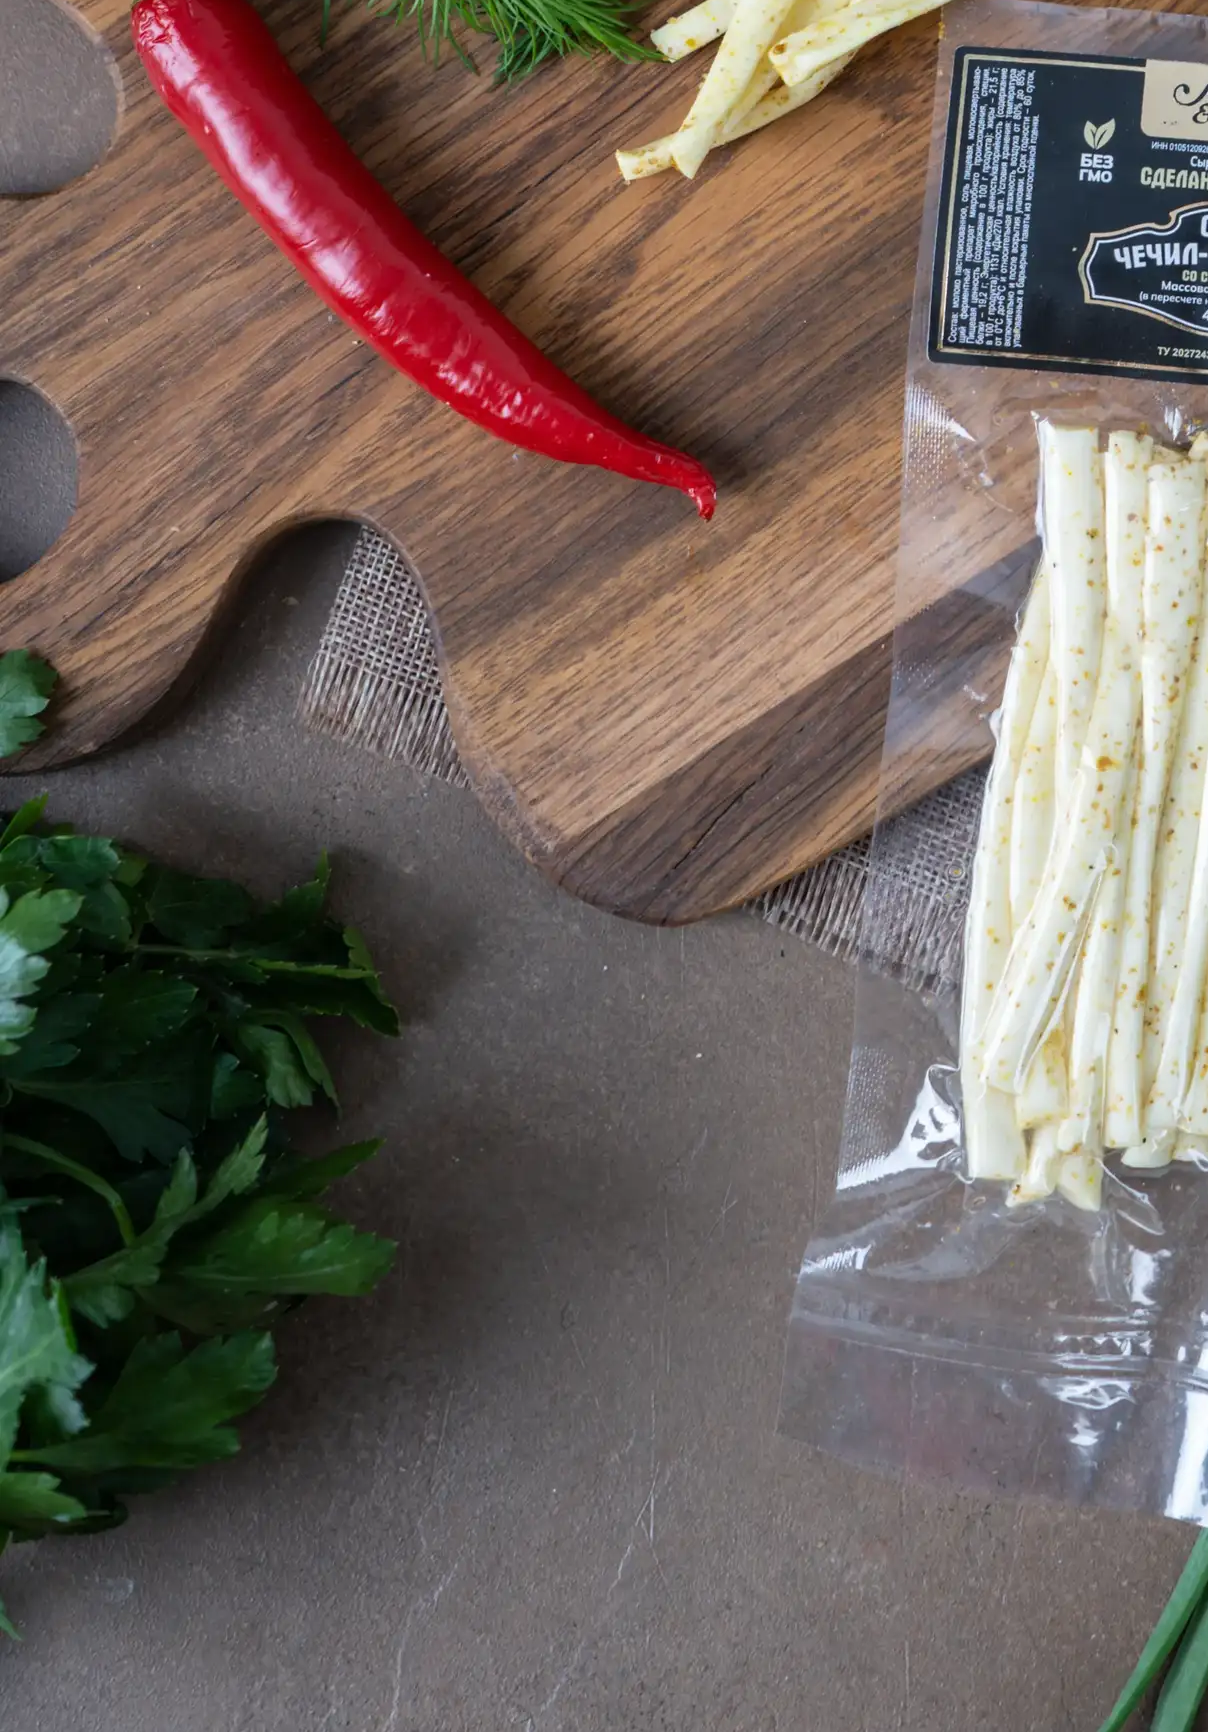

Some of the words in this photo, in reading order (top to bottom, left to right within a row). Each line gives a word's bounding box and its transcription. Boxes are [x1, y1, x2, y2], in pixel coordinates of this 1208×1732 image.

[989, 77, 999, 93] 21,5
[1016, 69, 1025, 85] 85%
[1026, 70, 1036, 92] суток,
[968, 66, 982, 139] молокосвертываю-
[995, 68, 1008, 117] (содержание
[1005, 68, 1017, 118] температура
[1016, 89, 1024, 100] до
[1023, 95, 1032, 105] 60
[987, 107, 996, 128] жиры
[1013, 102, 1022, 119] 80%
[974, 104, 987, 165] происхождения,
[1002, 120, 1012, 159] хранения:
[1013, 123, 1020, 132] от
[1020, 116, 1030, 151] годности
[964, 143, 974, 179] пищевая,
[982, 132, 994, 172] продукта):
[1010, 135, 1021, 165] воздуха
[1080, 153, 1114, 169] БЕЗ
[1151, 141, 1168, 151] ИНН
[987, 121, 1003, 212] ценность/калорийность
[997, 162, 1008, 194] Условия
[1017, 153, 1027, 173] Срок
[1024, 145, 1037, 200] многослойной
[1079, 168, 1113, 183] ГМО
[961, 183, 969, 201] соль
[968, 172, 981, 217] микробного
[978, 184, 987, 197] 100
[1006, 170, 1016, 210] влажность
[1015, 176, 1026, 213] упаковки.
[996, 198, 1004, 216] ккал.
[1024, 202, 1031, 211] из
[955, 206, 968, 275] пастеризованное,
[973, 212, 986, 262] (содержание
[991, 219, 1003, 250] кДж/270
[1011, 216, 1022, 253] вскрытия
[1021, 213, 1030, 241] пакеты
[964, 224, 976, 261] препарат
[980, 216, 994, 278] Энергетическая
[1000, 214, 1012, 273] относительная
[989, 254, 999, 270] 1131
[1009, 256, 1017, 279] после
[1015, 244, 1029, 287] барьерные
[952, 279, 960, 307] молоко
[959, 268, 972, 319] ферментный
[971, 267, 981, 303] ценность
[978, 292, 988, 307] 19,2
[987, 274, 999, 315] продукта):
[1139, 291, 1149, 301] (в
[1151, 292, 1203, 306] пересчете
[947, 312, 958, 342] Состав:
[966, 307, 978, 343] Пищевая
[975, 321, 985, 344] белки
[984, 323, 994, 336] 100
[1003, 291, 1015, 346] включительно
[1012, 296, 1025, 347] упакованных
[957, 326, 966, 342] щий
[994, 336, 1001, 345] от
[1157, 346, 1171, 356] ТУ
